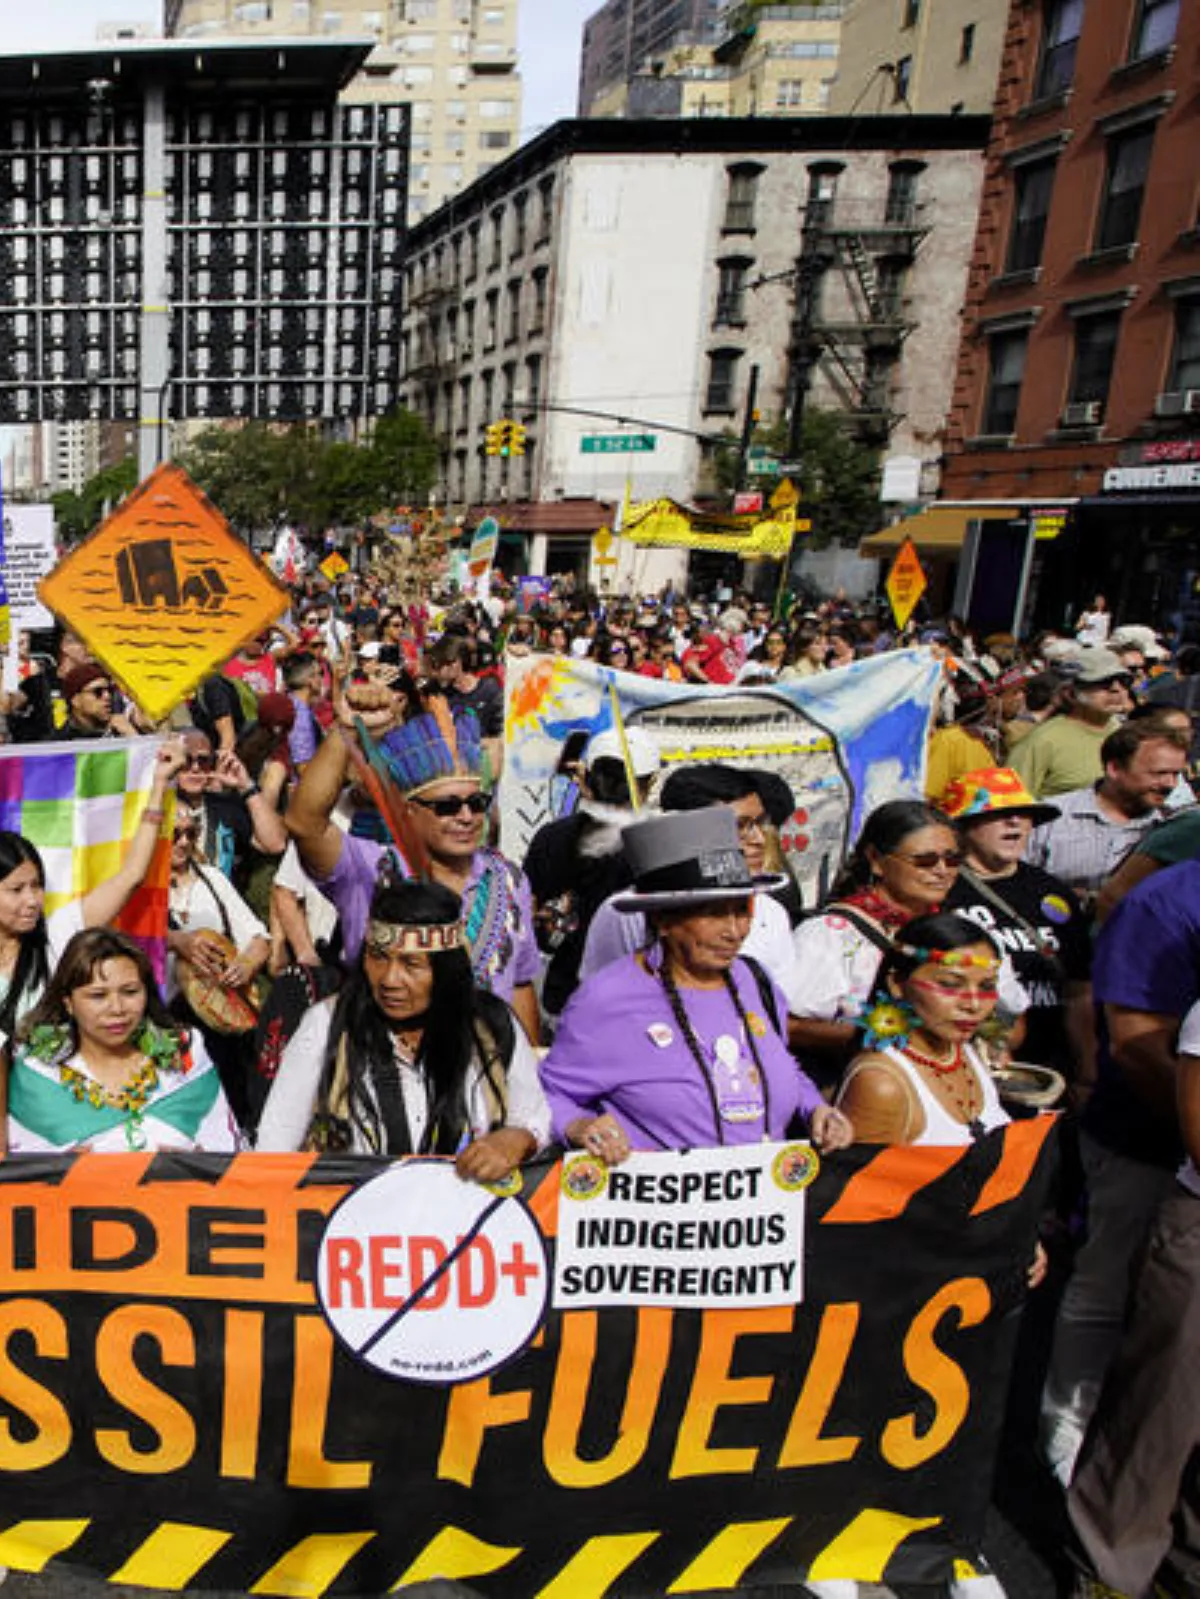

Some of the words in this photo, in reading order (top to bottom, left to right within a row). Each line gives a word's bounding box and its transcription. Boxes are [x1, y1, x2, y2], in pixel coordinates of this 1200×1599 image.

[607, 1166, 762, 1204] RESPECT
[576, 1213, 786, 1251] INDIGENOUS
[326, 1235, 539, 1312] REDD+
[560, 1260, 796, 1296] SOVEREIGNTY
[390, 1349, 492, 1372] no-redd.com
